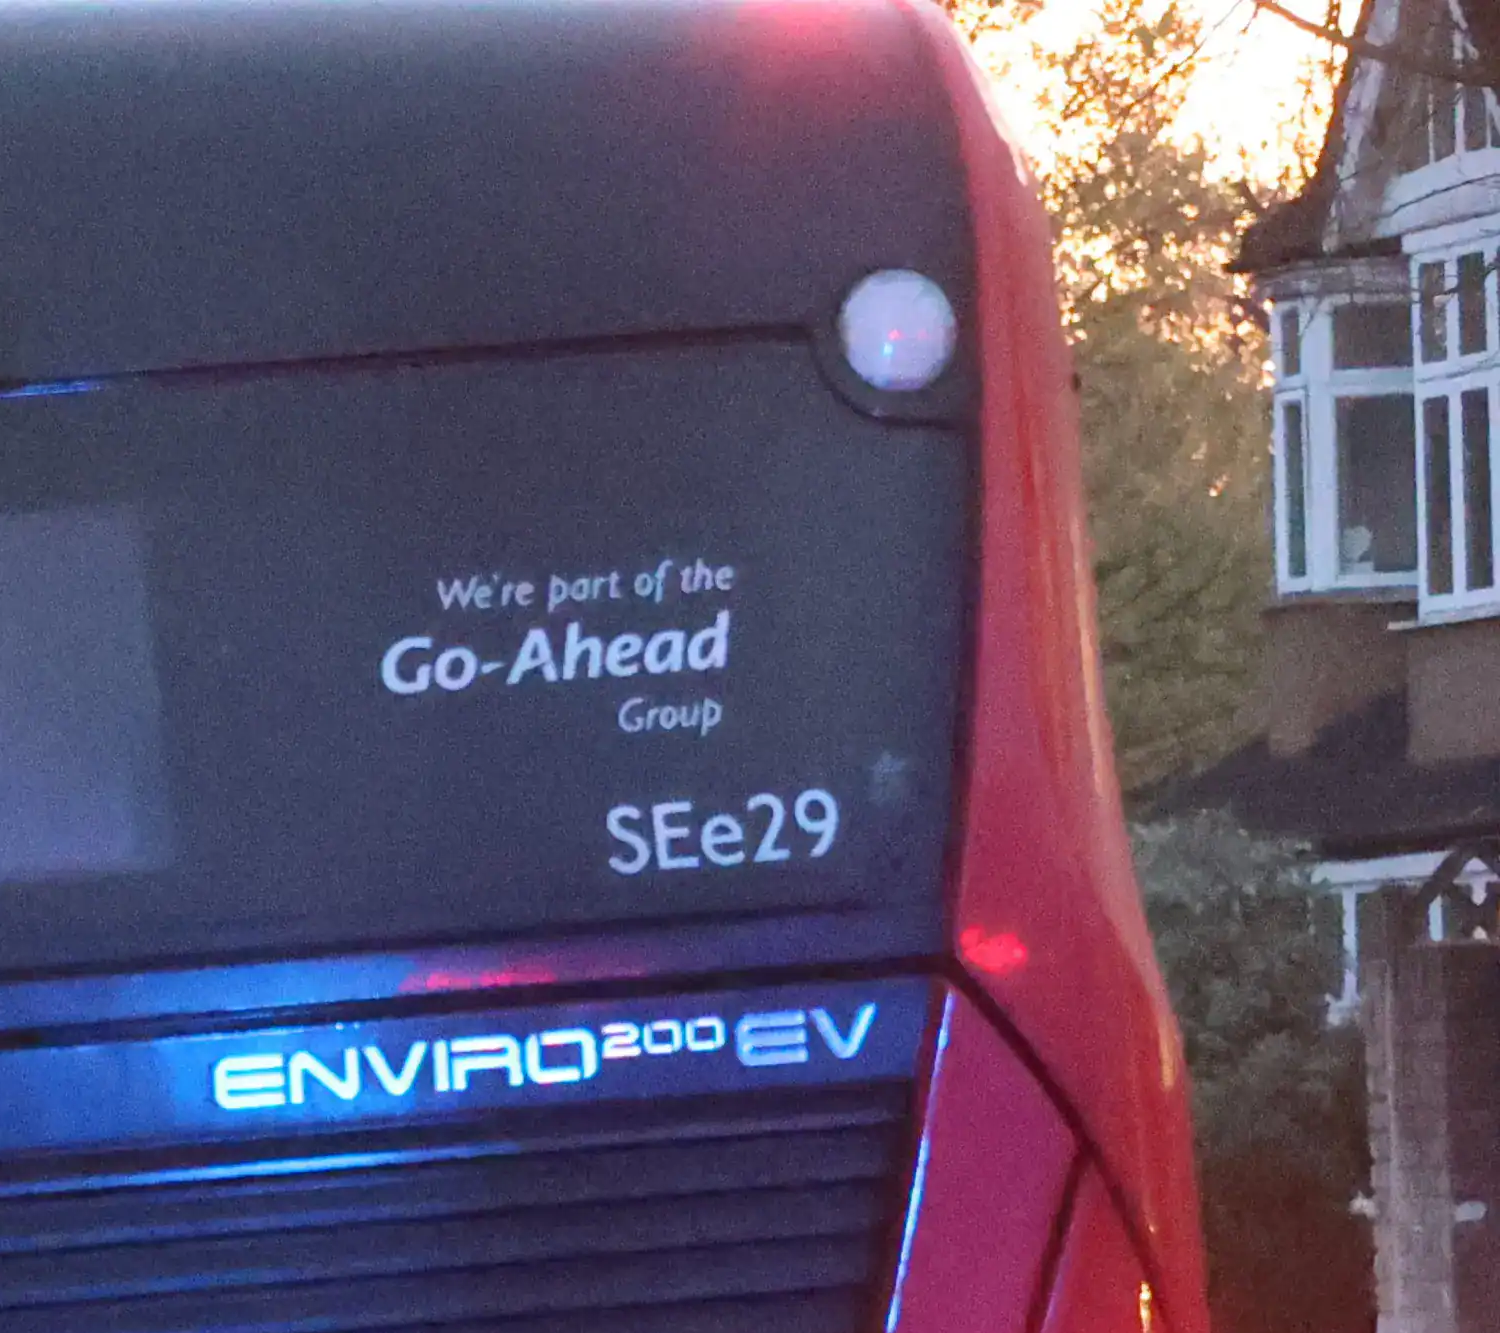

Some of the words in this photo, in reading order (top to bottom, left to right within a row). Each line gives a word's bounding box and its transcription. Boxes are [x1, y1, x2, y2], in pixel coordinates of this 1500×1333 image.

[437, 573, 534, 611] We're
[548, 568, 620, 612] part
[634, 558, 674, 604] of
[681, 557, 735, 593] the
[381, 608, 731, 695] Go-Ahead
[618, 696, 723, 736] Group
[606, 787, 840, 876] SEe29
